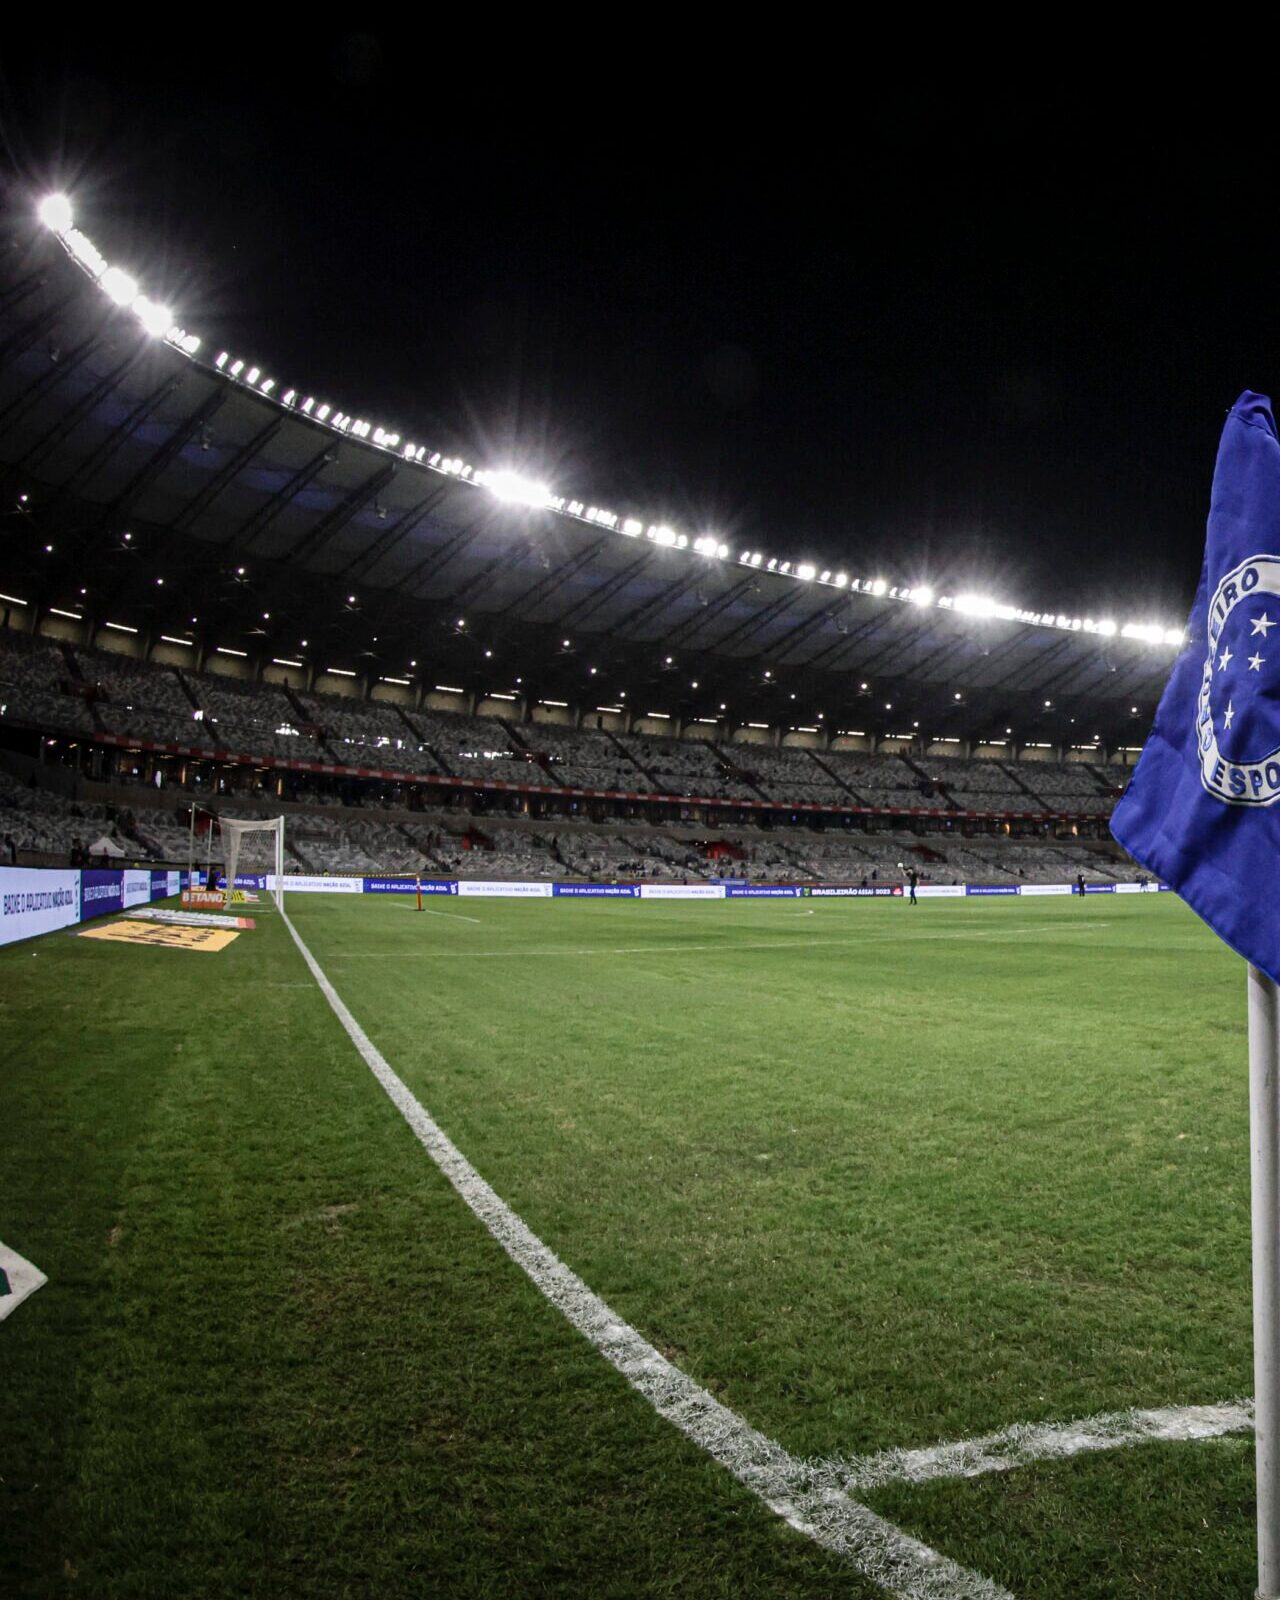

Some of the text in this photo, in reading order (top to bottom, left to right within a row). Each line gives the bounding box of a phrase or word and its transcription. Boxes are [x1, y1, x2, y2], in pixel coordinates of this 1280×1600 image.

[182, 892, 222, 902] BETANO
[812, 888, 858, 896] BRASILEIRÃO
[4, 894, 20, 916] BAIXE
[26, 890, 52, 912] APLICATIVO
[52, 887, 65, 910] NAÇÃO
